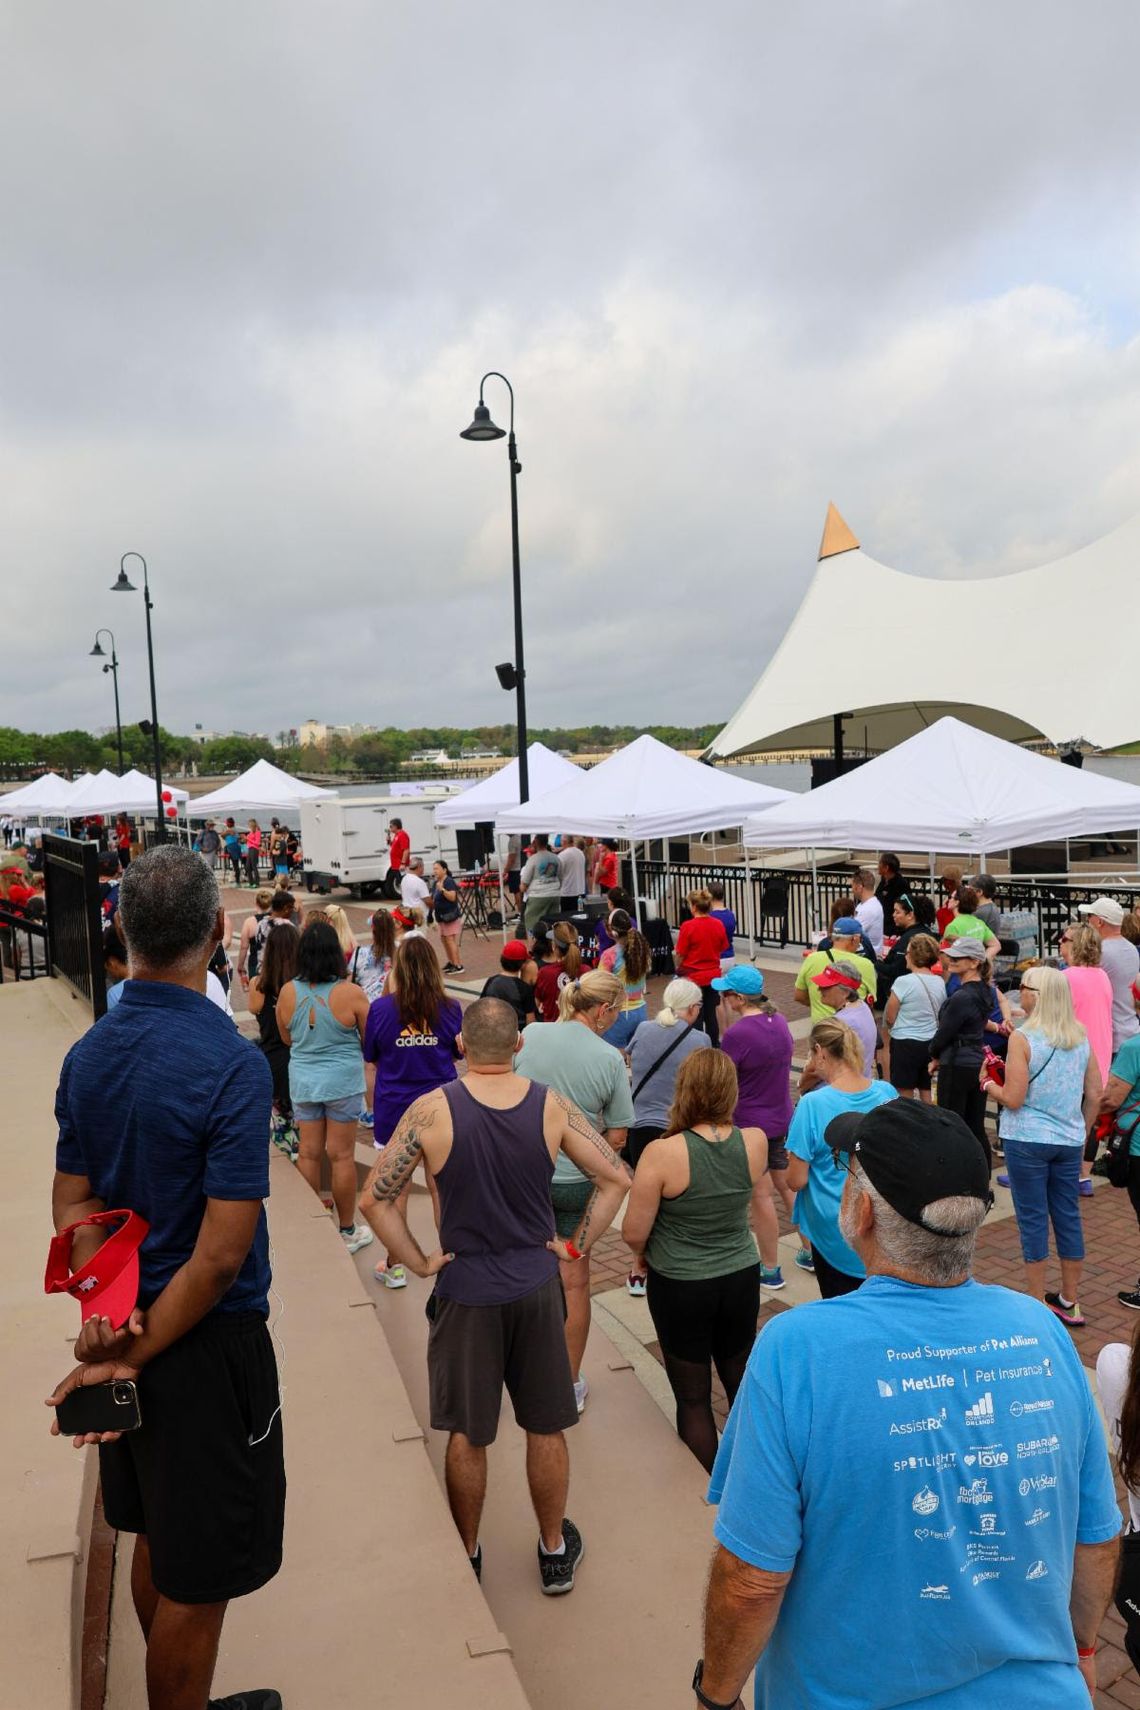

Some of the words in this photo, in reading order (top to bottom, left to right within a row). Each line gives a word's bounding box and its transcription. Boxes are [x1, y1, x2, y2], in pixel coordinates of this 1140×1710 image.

[395, 1034, 439, 1047] adidas
[886, 1346, 922, 1362] Proud
[924, 1345, 977, 1360] Supporter
[980, 1339, 990, 1352] of
[991, 1338, 1008, 1351] Pet
[902, 1374, 955, 1392] MetLife
[975, 1369, 996, 1383] Pet
[999, 1365, 1043, 1380] Insurance
[889, 1418, 943, 1436] AssistRx
[978, 1450, 1009, 1466] love
